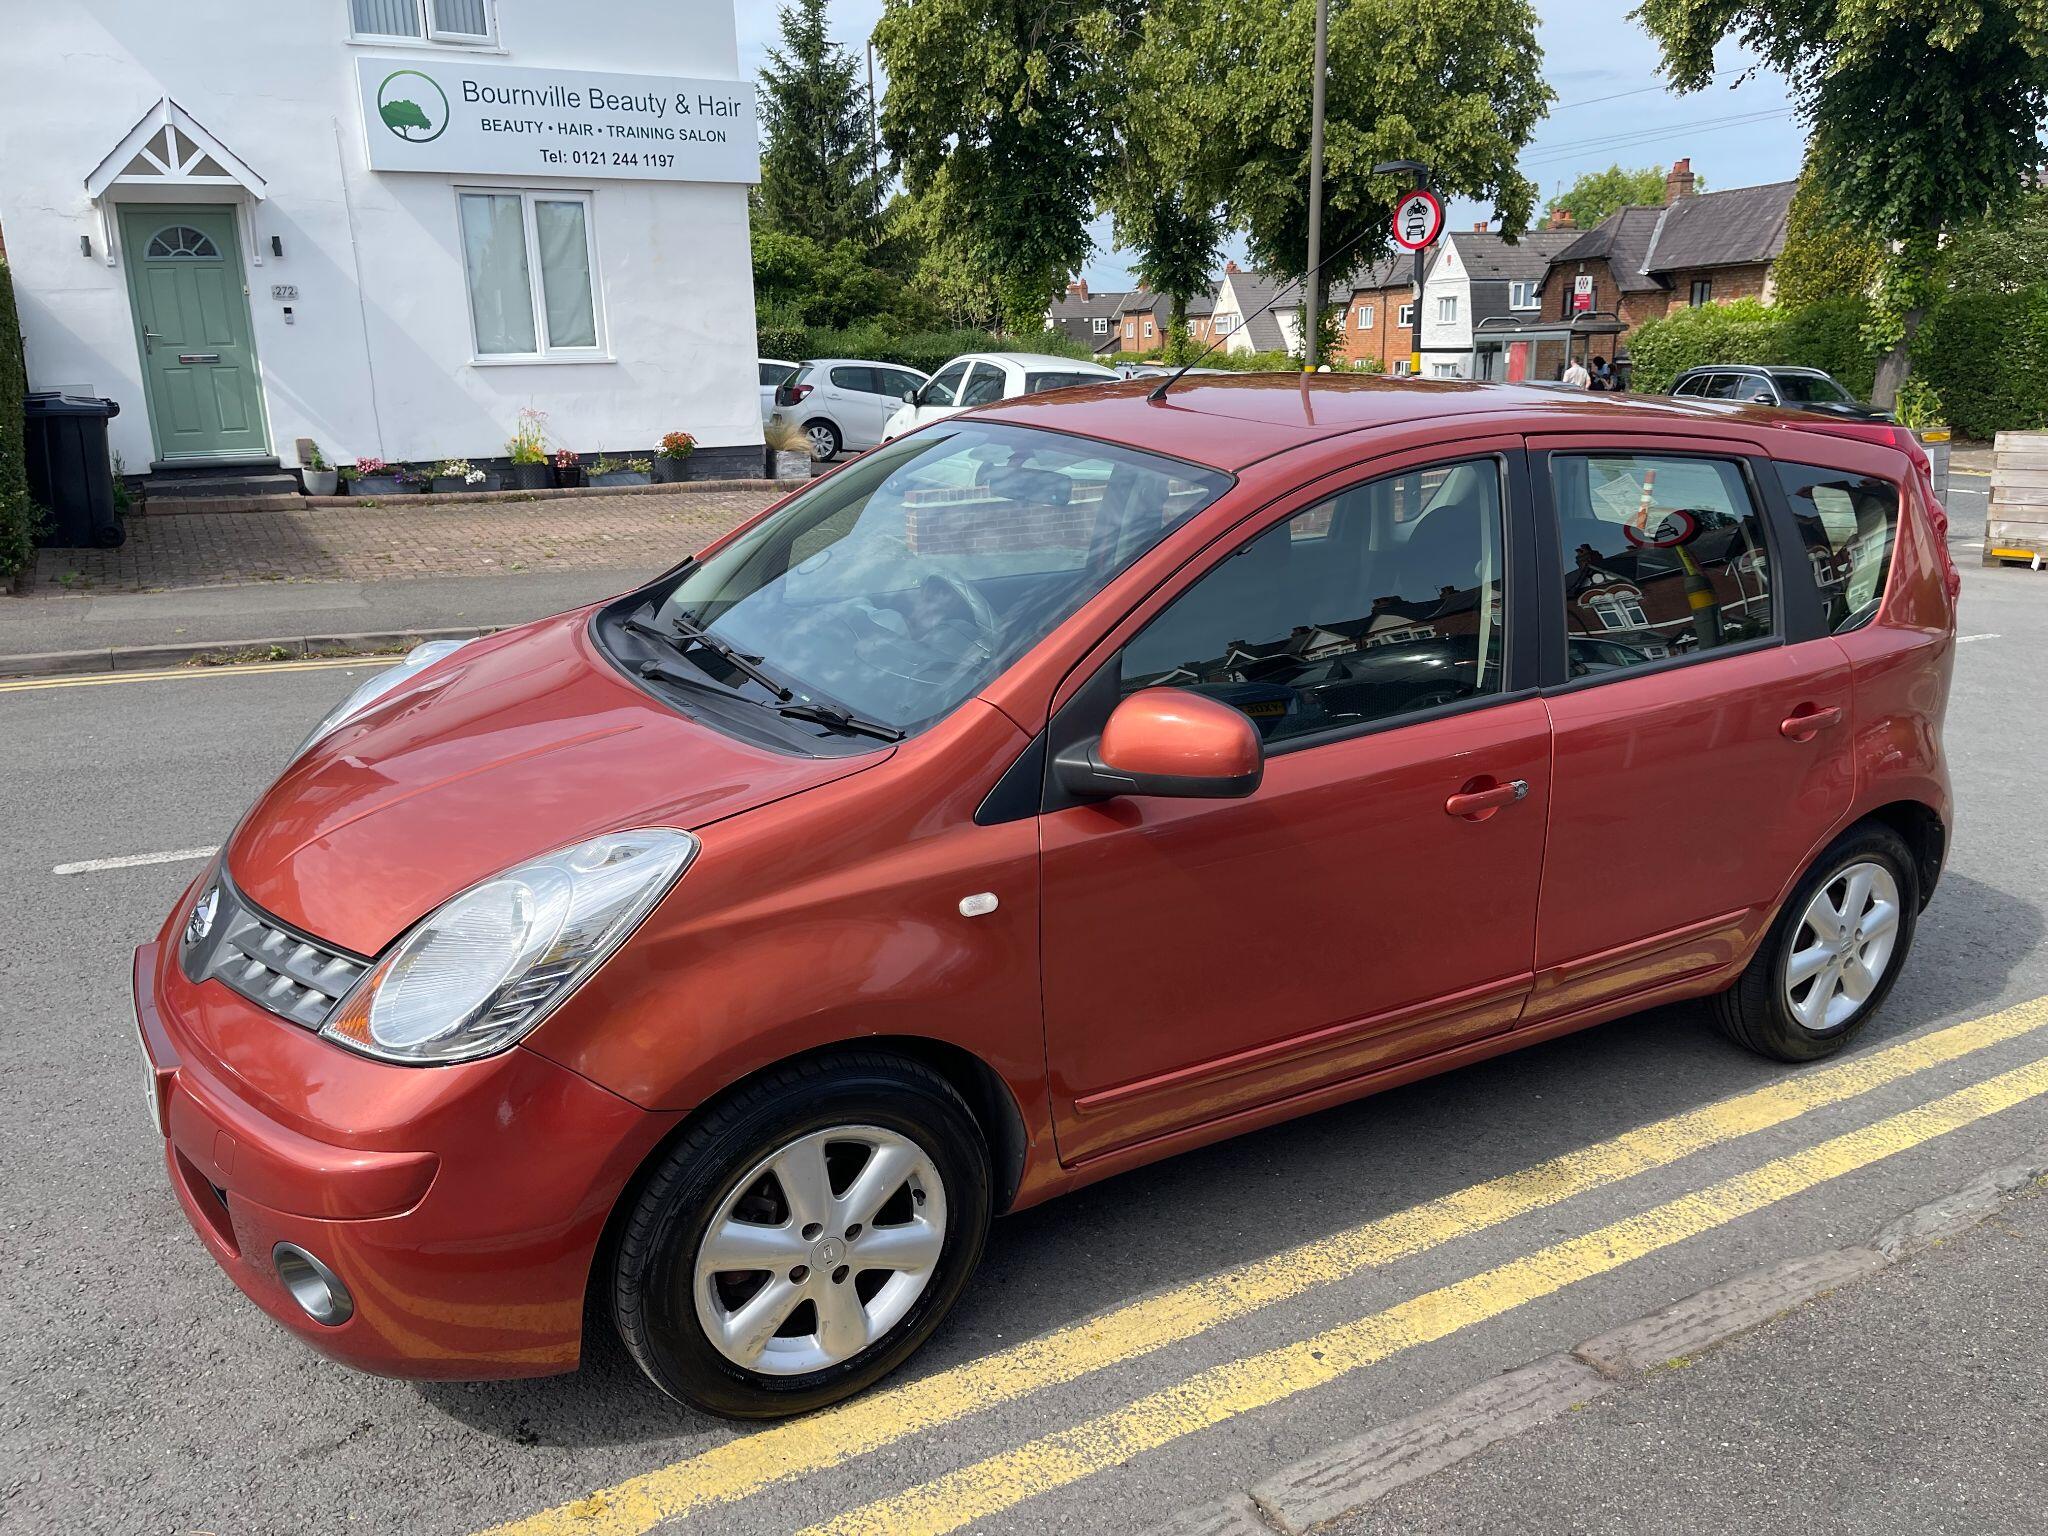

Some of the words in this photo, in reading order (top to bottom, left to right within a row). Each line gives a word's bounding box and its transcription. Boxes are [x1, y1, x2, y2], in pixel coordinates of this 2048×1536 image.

[462, 80, 580, 108] Bournville
[588, 87, 667, 119] Beauty
[675, 93, 691, 115] &
[698, 94, 741, 118] Hair
[481, 118, 544, 134] BEAUTY
[557, 122, 594, 136] HAIR
[606, 125, 675, 140] TRAINING
[679, 128, 726, 143] SALON
[540, 149, 567, 164] Tel:
[572, 150, 606, 165] 0121
[612, 152, 639, 167] 244
[643, 153, 675, 168] 1197
[275, 286, 294, 296] 272
